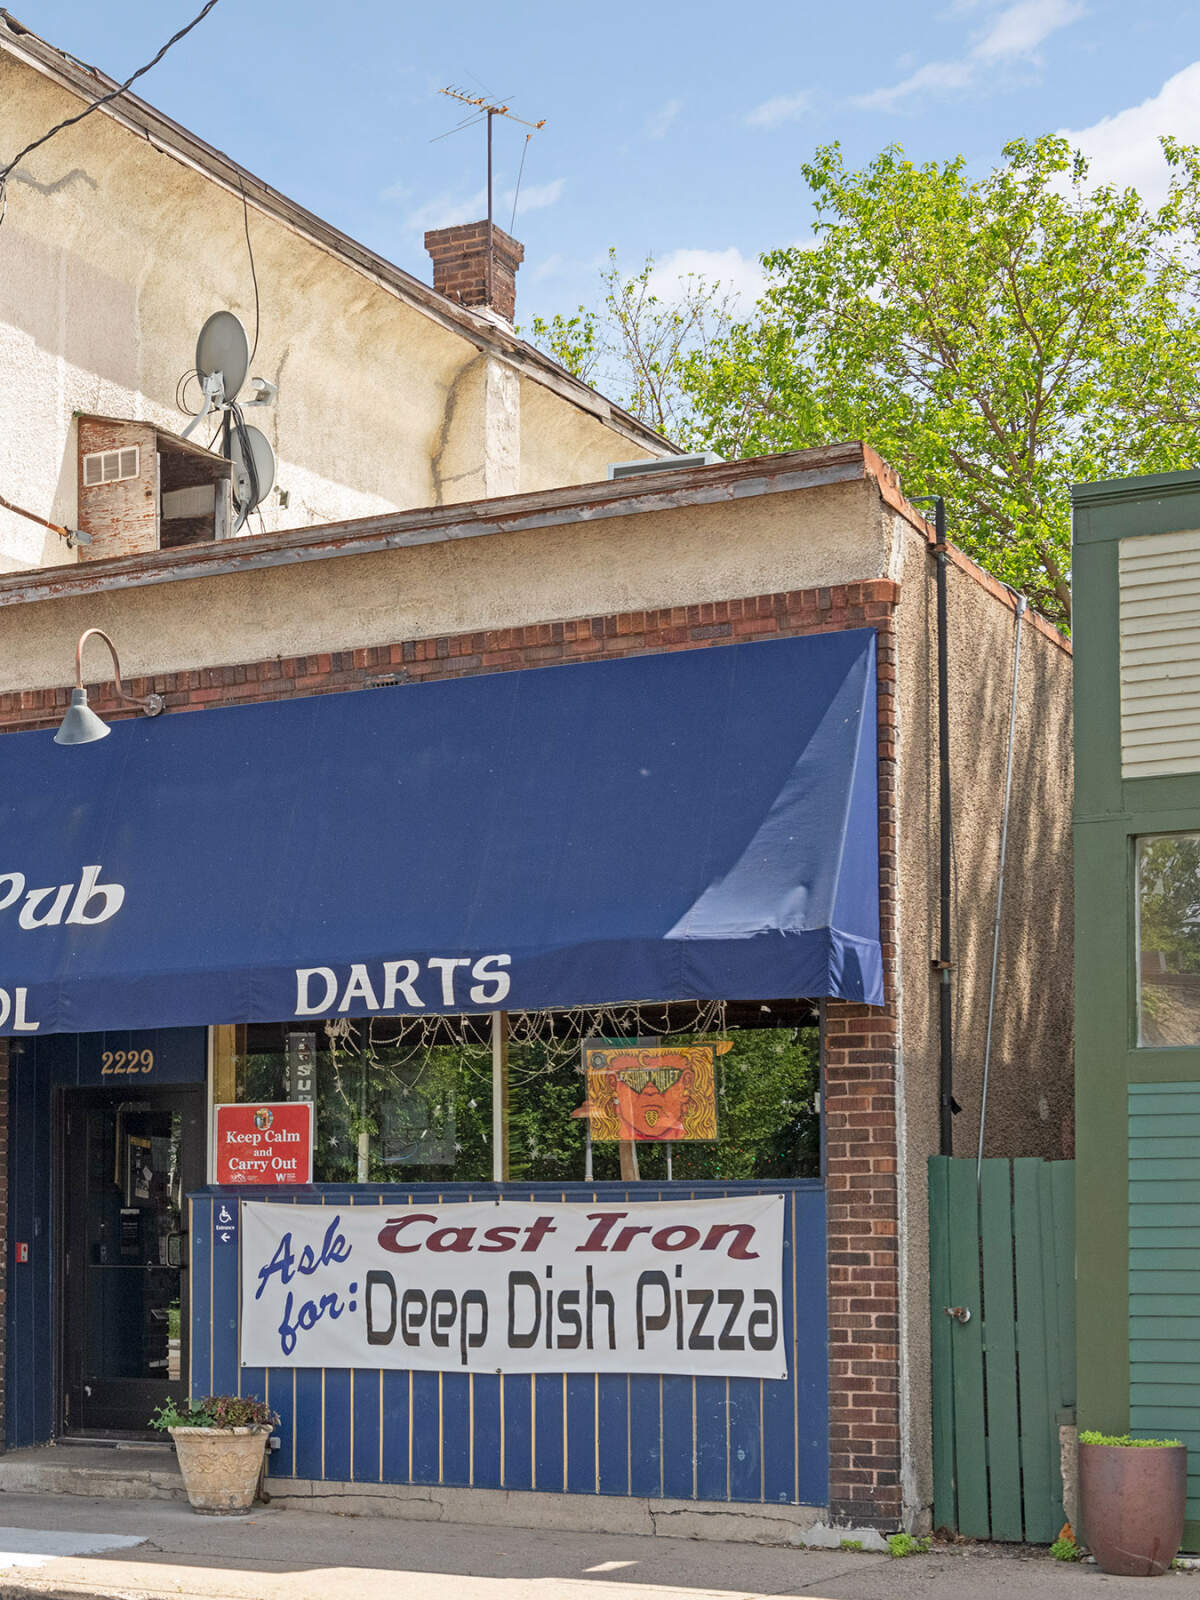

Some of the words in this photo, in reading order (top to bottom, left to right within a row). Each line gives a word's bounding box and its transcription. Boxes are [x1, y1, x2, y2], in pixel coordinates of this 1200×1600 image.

[294, 953, 511, 1016] DARTS
[101, 1049, 154, 1075] 2229
[226, 1131, 262, 1146] Keep
[264, 1129, 300, 1143] Calm
[253, 1147, 273, 1157] and
[228, 1158, 269, 1173] Carry
[271, 1157, 297, 1170] Out
[257, 1216, 352, 1299] Ask
[377, 1213, 556, 1253] Cast
[574, 1212, 761, 1260] Iron
[278, 1281, 359, 1356] for:
[364, 1269, 490, 1365] Deep
[507, 1264, 617, 1351] Dish
[636, 1264, 780, 1352] Pizza
